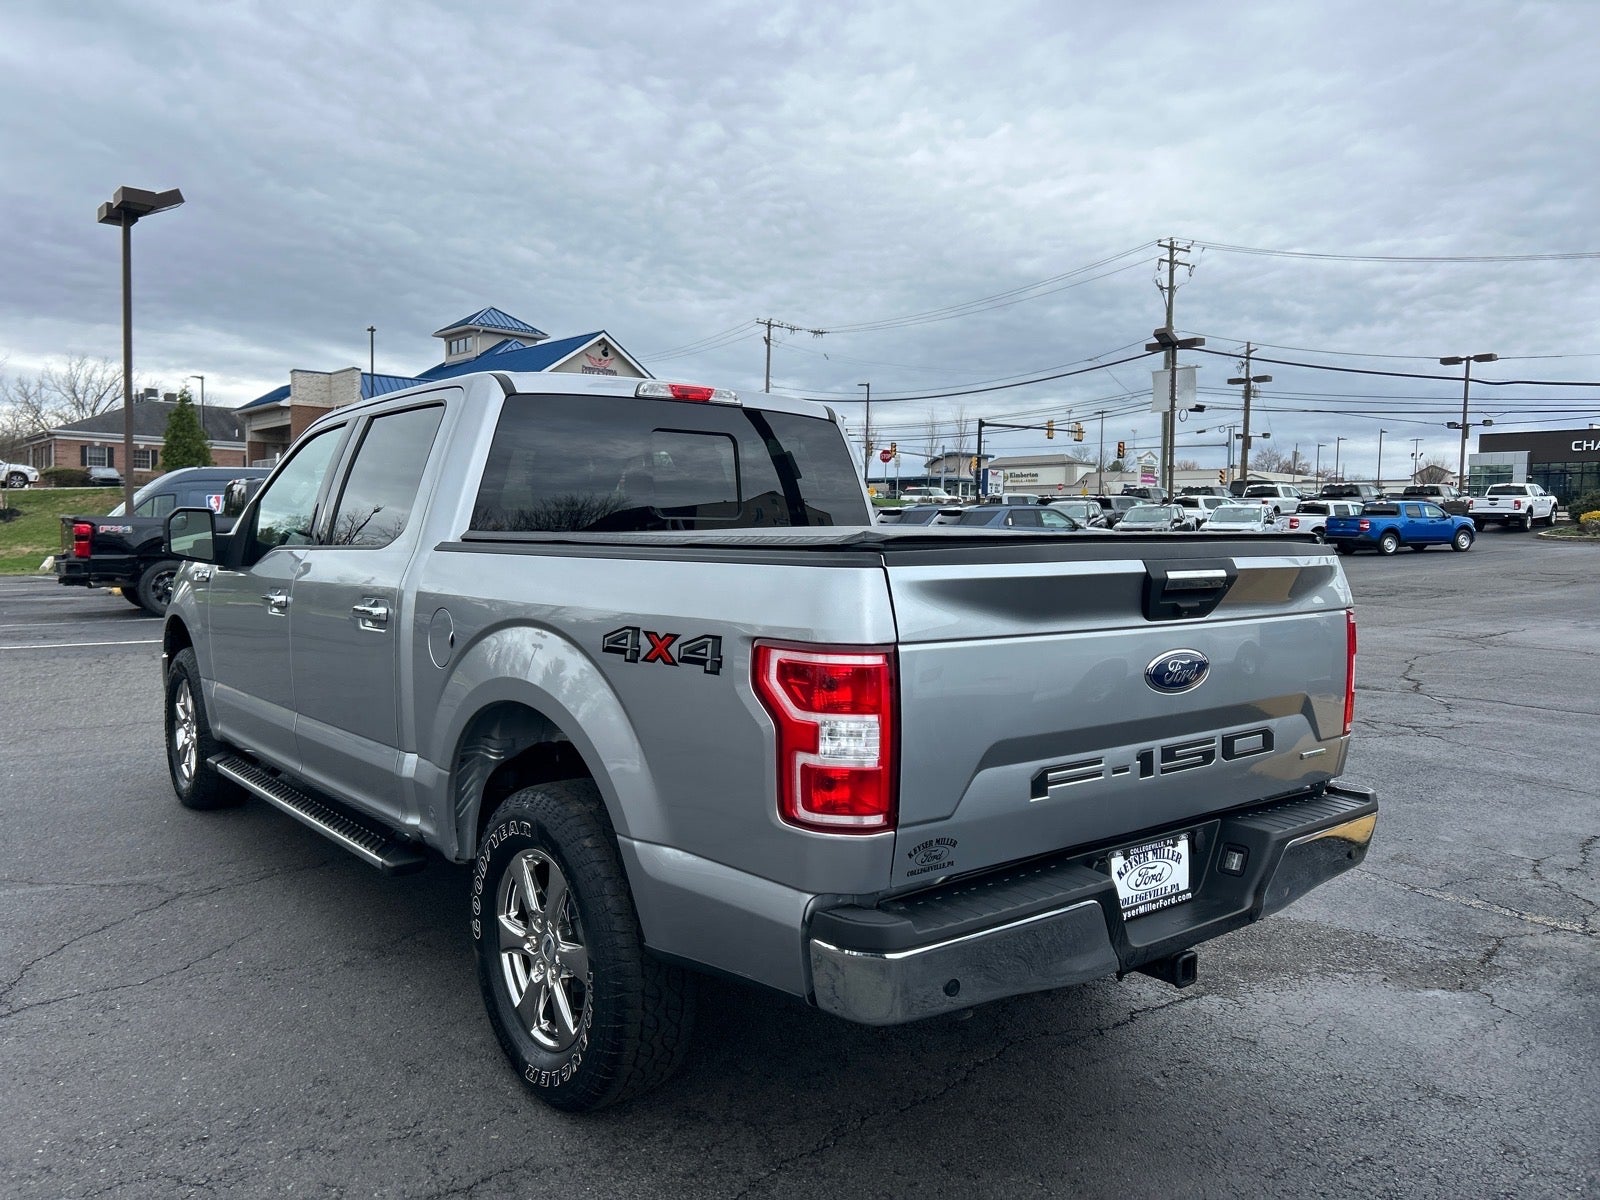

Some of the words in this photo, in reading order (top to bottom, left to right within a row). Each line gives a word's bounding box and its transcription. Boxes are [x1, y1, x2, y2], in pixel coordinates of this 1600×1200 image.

[1164, 659, 1198, 684] Ford
[1029, 727, 1275, 802] F-150
[907, 840, 934, 859] KEYSER
[935, 837, 958, 849] MILLER
[920, 848, 944, 864] Ford
[1116, 851, 1150, 881] KEYSER
[1151, 848, 1182, 865] MILLER
[1134, 865, 1165, 888] Ford
[471, 820, 532, 940] GOODYEAR
[1120, 882, 1180, 907] OLLEGEVILLE,PA
[1122, 892, 1192, 921] yserMillerFord.com
